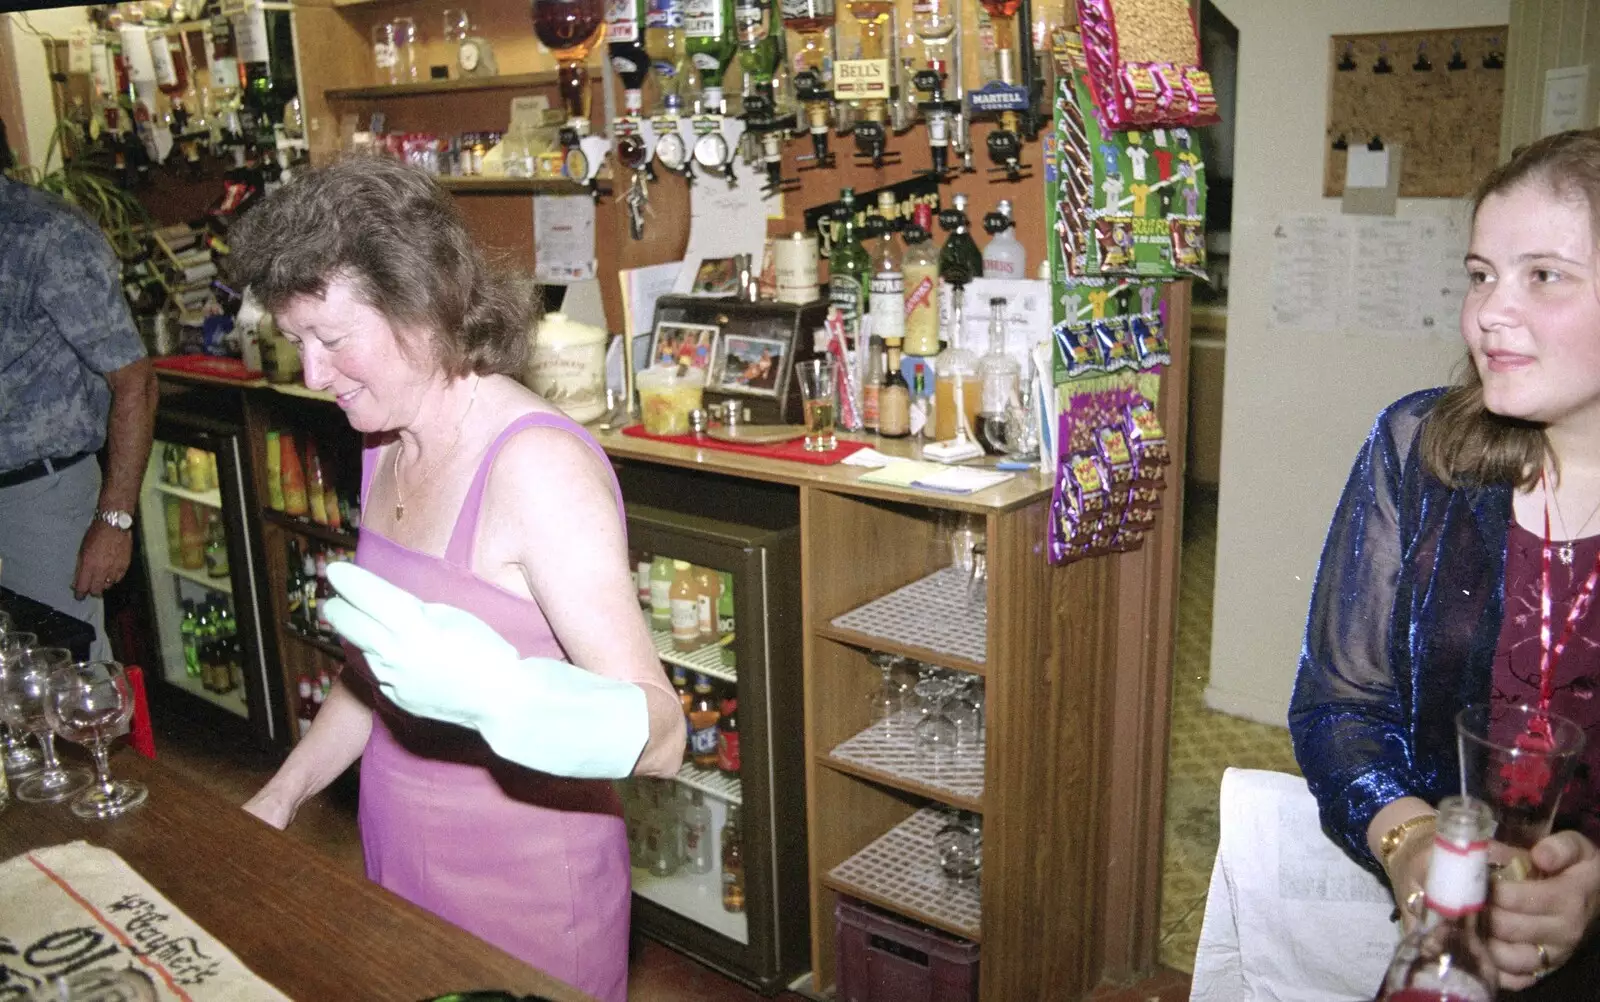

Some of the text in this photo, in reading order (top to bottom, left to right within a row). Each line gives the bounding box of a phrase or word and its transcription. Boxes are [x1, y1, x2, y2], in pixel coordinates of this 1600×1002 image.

[839, 63, 881, 78] BELL'S
[972, 92, 1023, 105] MARTELL
[691, 730, 717, 752] ICE
